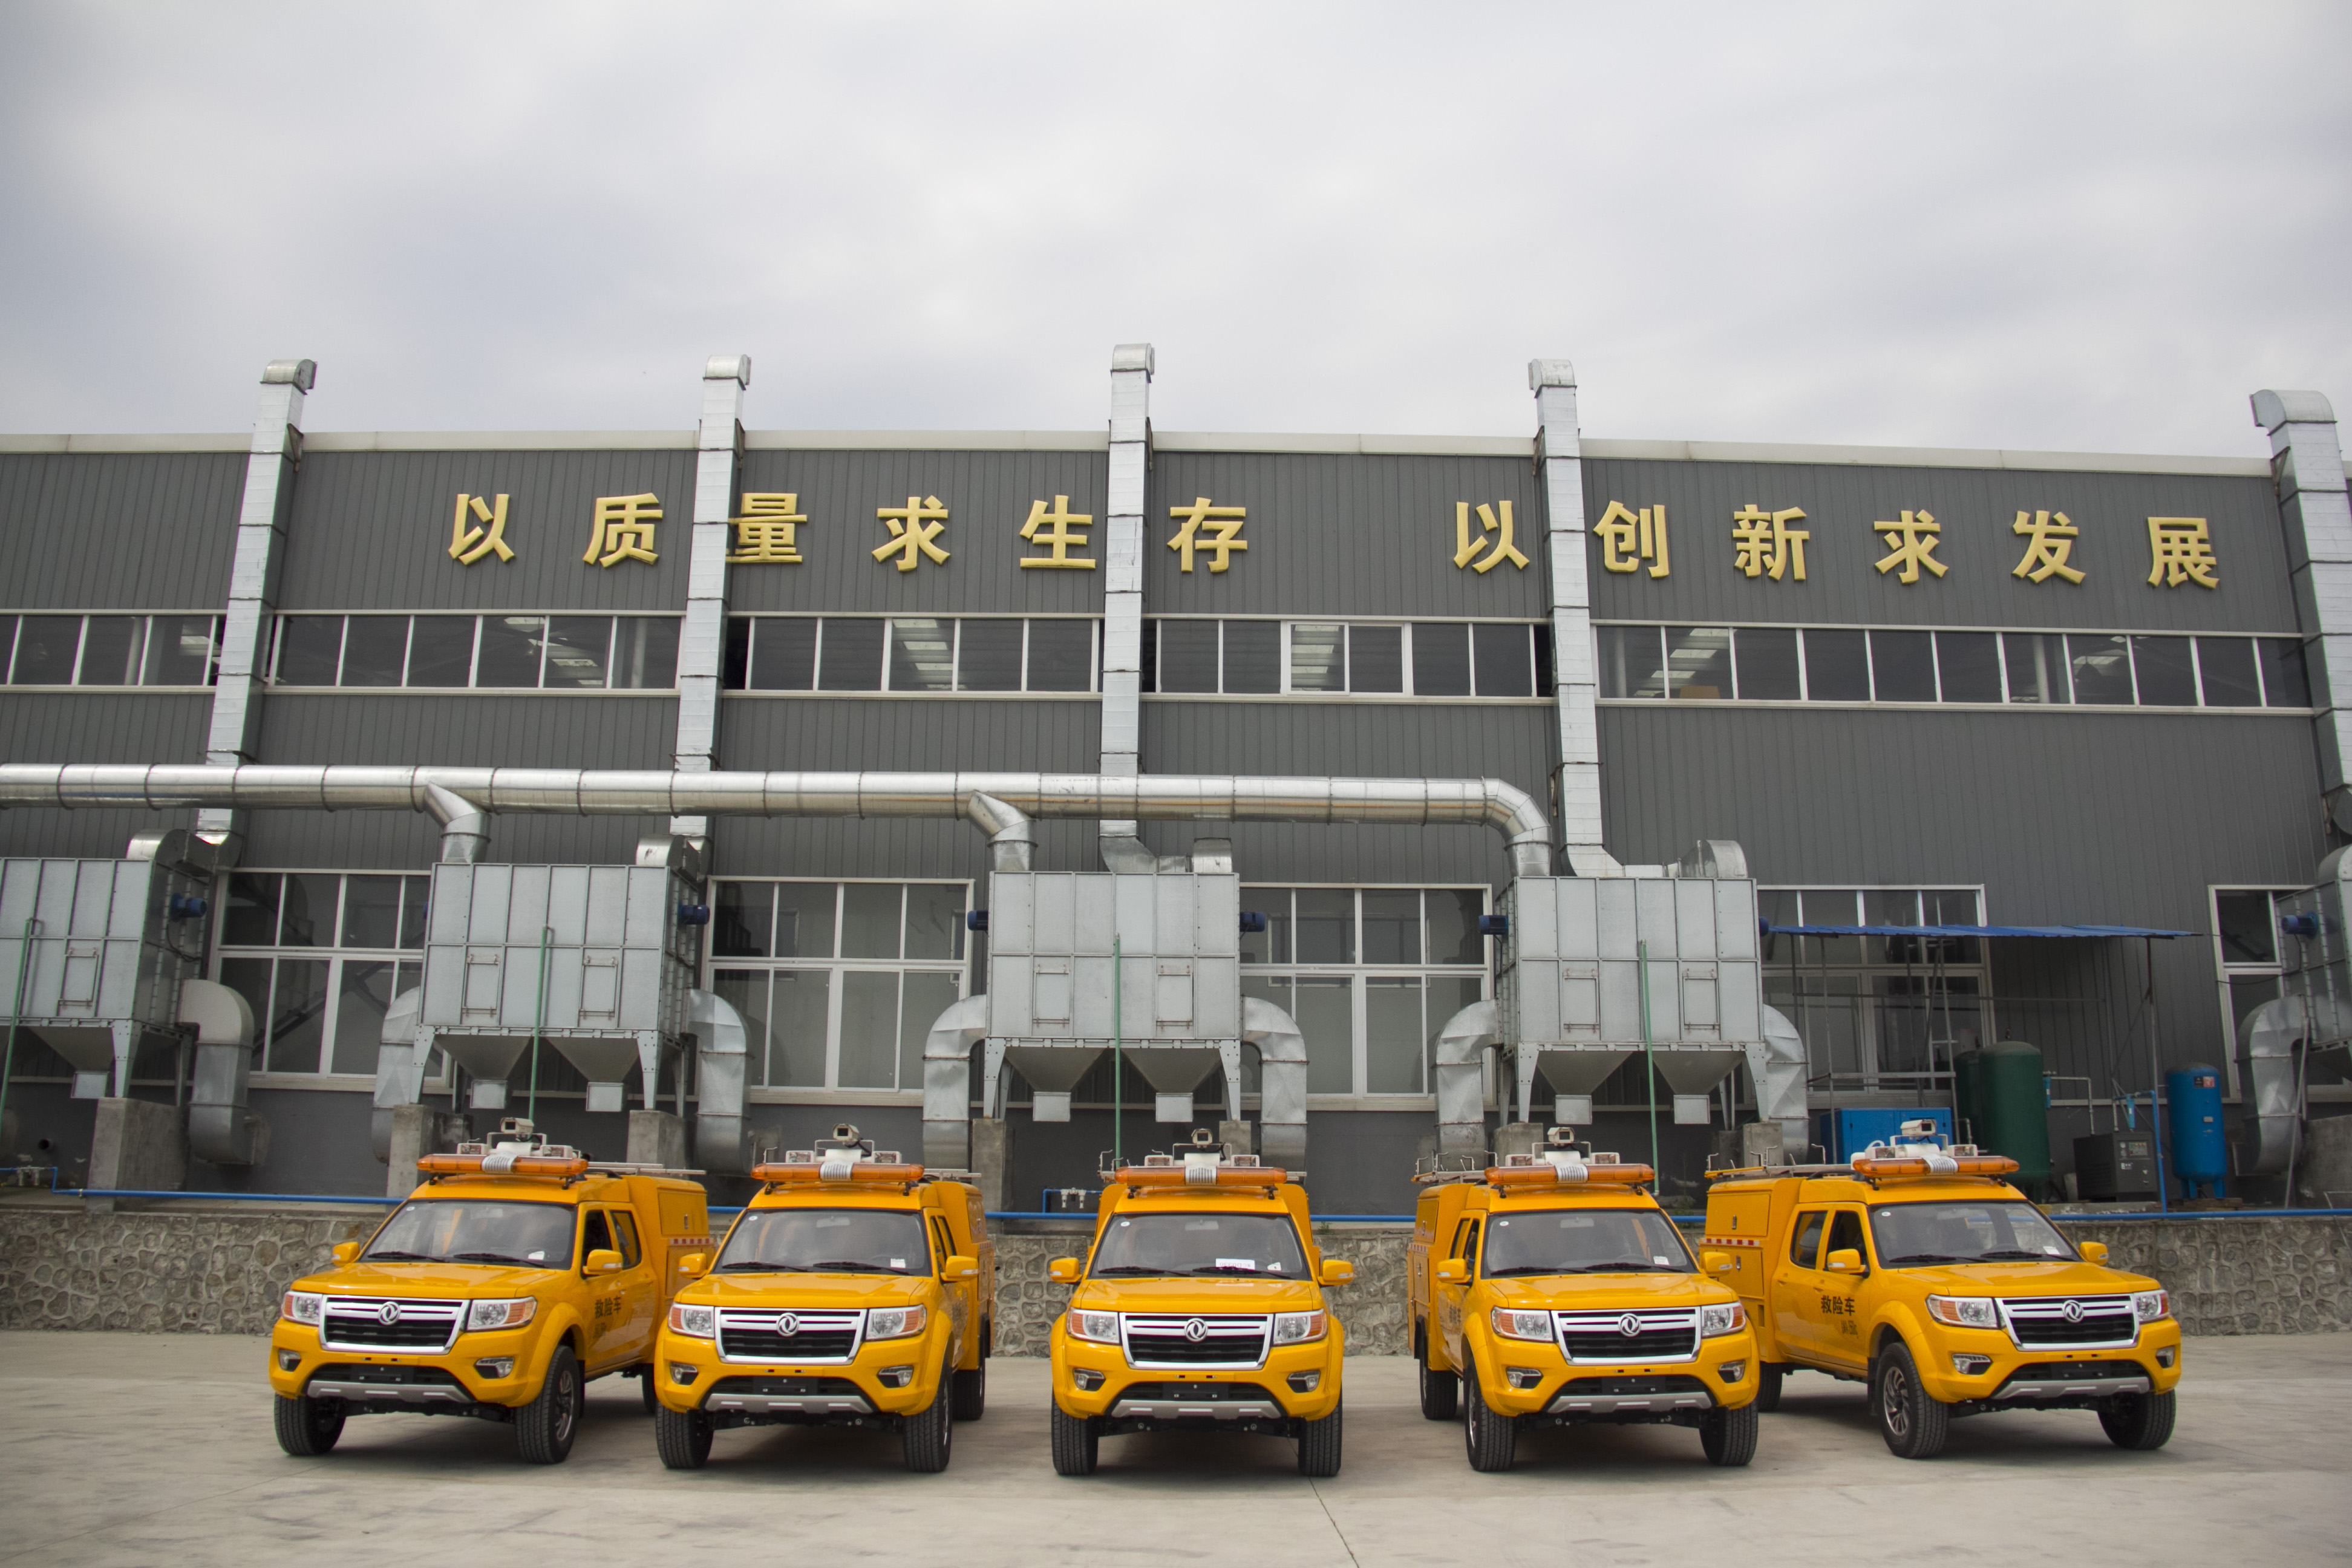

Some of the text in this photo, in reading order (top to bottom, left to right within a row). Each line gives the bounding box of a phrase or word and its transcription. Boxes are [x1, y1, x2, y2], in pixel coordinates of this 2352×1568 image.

[448, 492, 2218, 589] 以质量求生存 以创新求发展
[1821, 1295, 1855, 1316] 救险车
